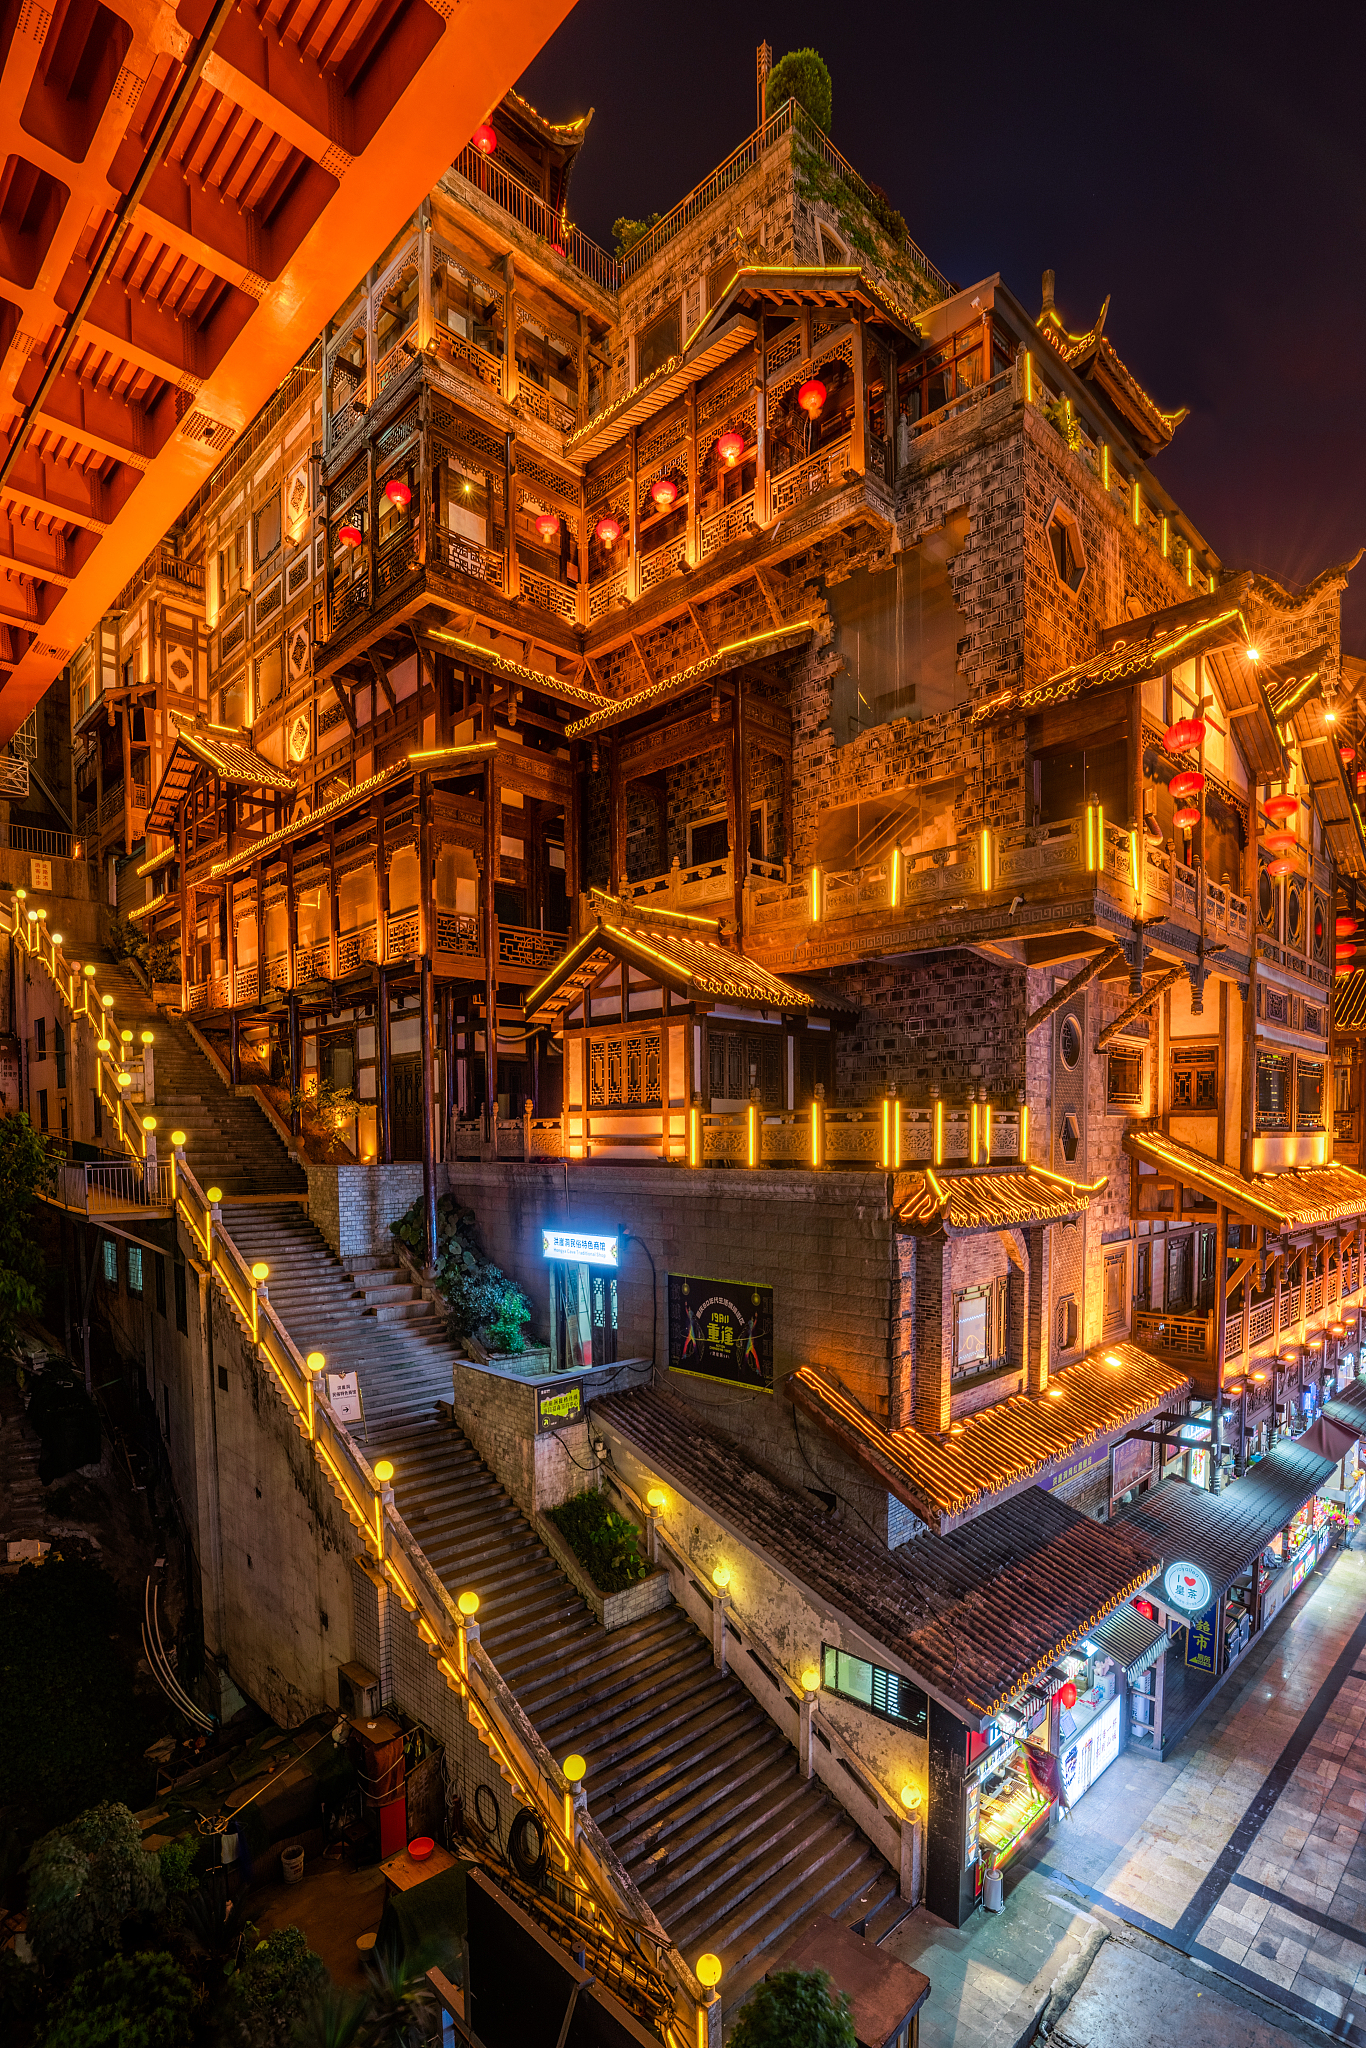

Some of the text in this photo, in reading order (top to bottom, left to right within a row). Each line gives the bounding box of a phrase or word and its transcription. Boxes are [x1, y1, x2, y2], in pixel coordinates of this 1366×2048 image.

[707, 1323, 734, 1346] 重逢
[1175, 1585, 1197, 1599] 皇茶
[1193, 1620, 1212, 1651] 超市
